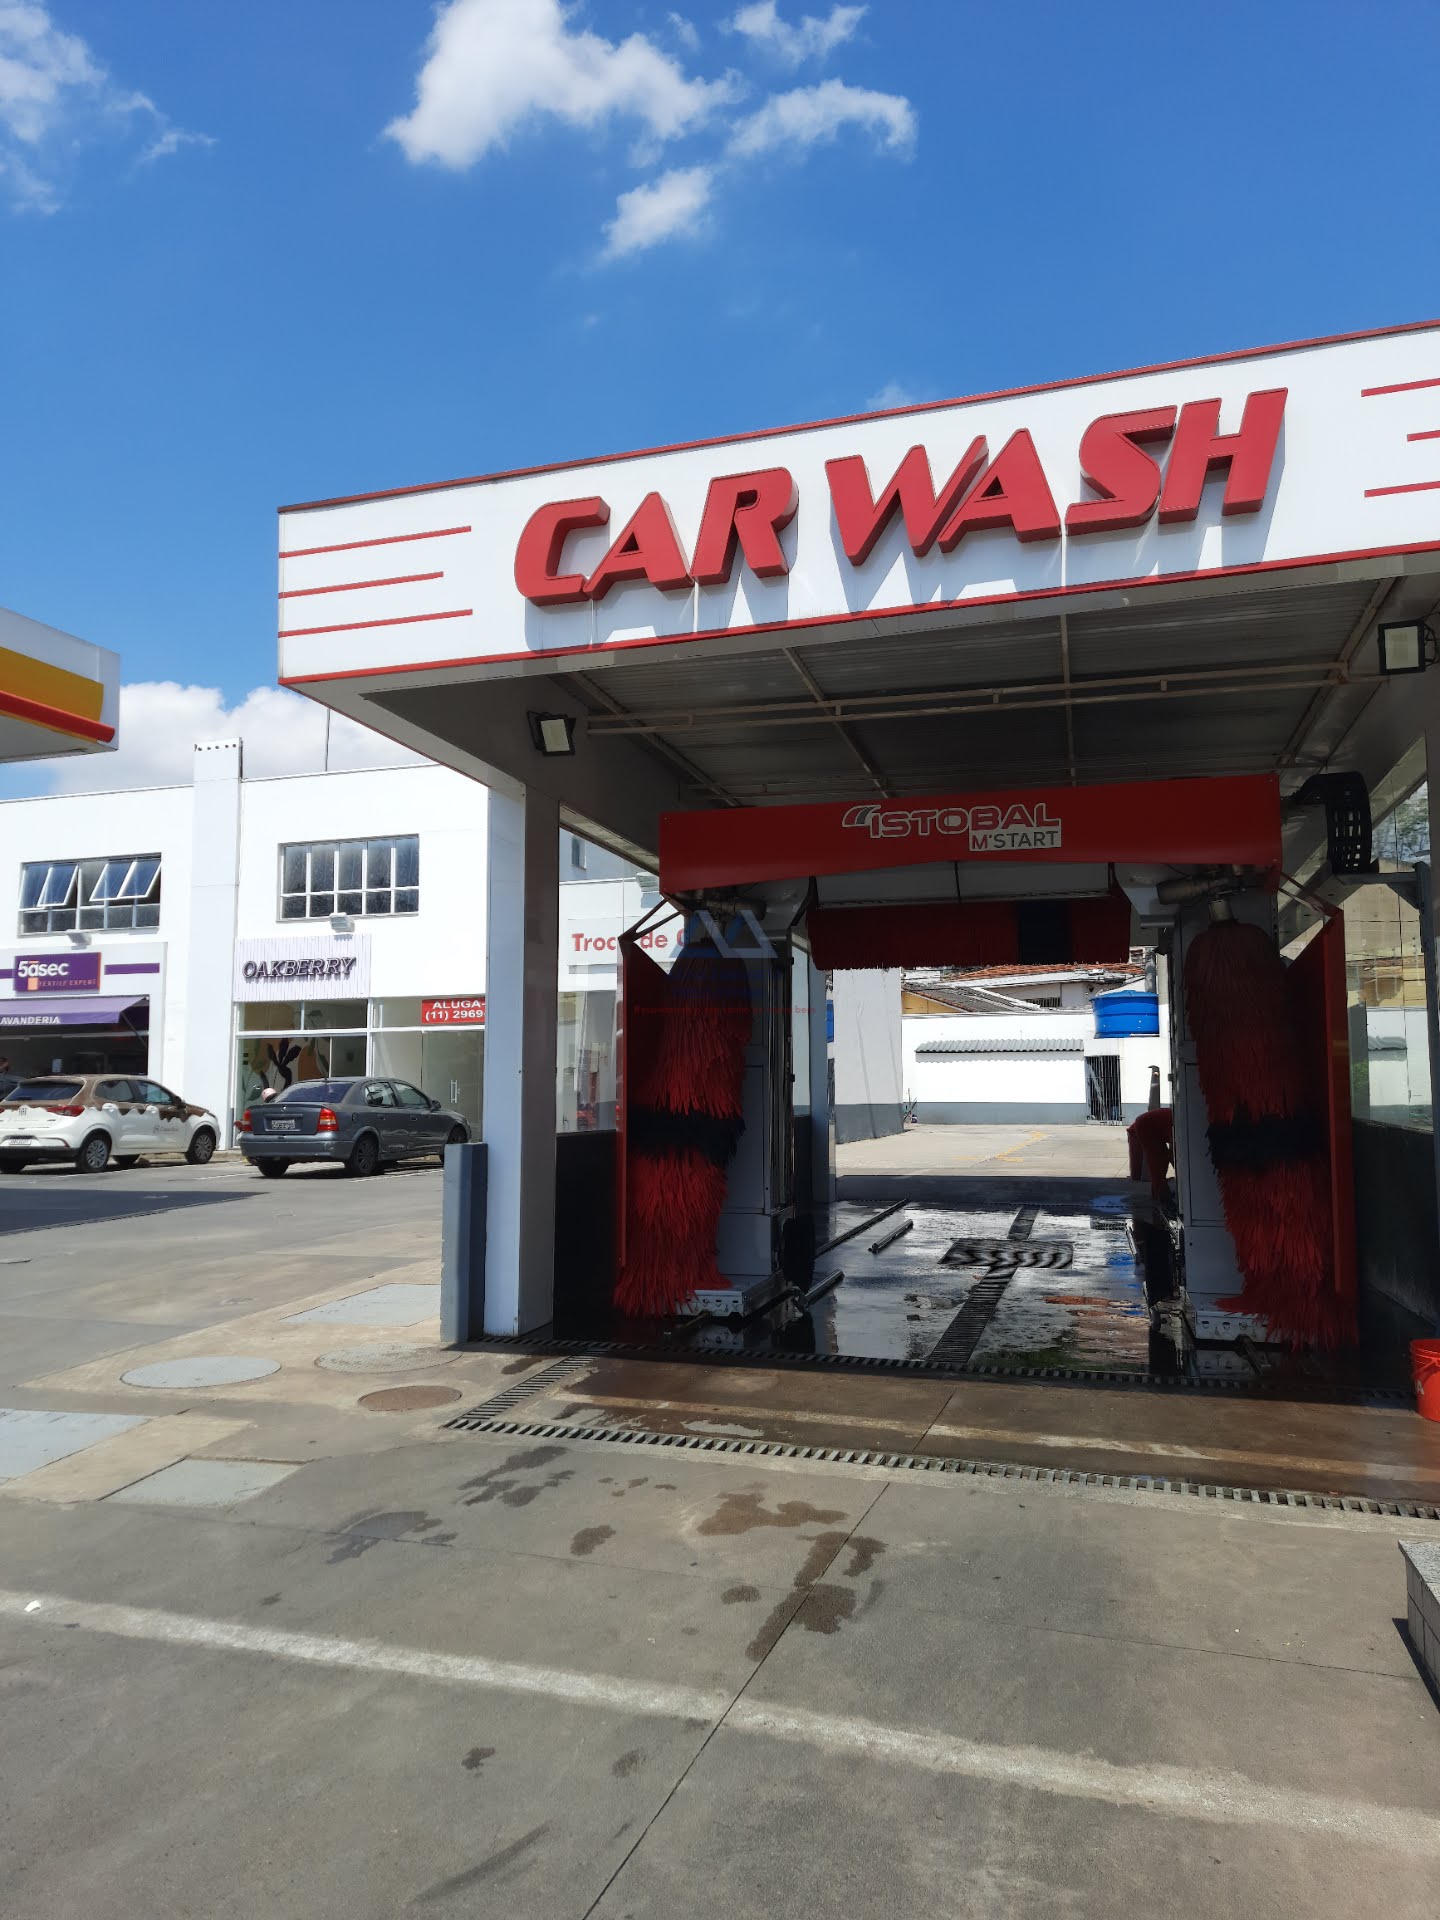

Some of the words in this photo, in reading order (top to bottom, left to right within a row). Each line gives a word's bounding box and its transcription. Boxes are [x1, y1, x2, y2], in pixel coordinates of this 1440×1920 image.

[514, 467, 799, 606] CAR
[825, 387, 1288, 566] WASH
[868, 803, 1062, 839] ISTOBAL
[571, 933, 618, 952] Troc
[640, 931, 668, 949] de
[242, 957, 357, 980] OAKBERRY
[0, 1016, 61, 1025] AVANDERIA
[425, 1011, 449, 1021] (11)
[452, 1010, 486, 1019] 2969
